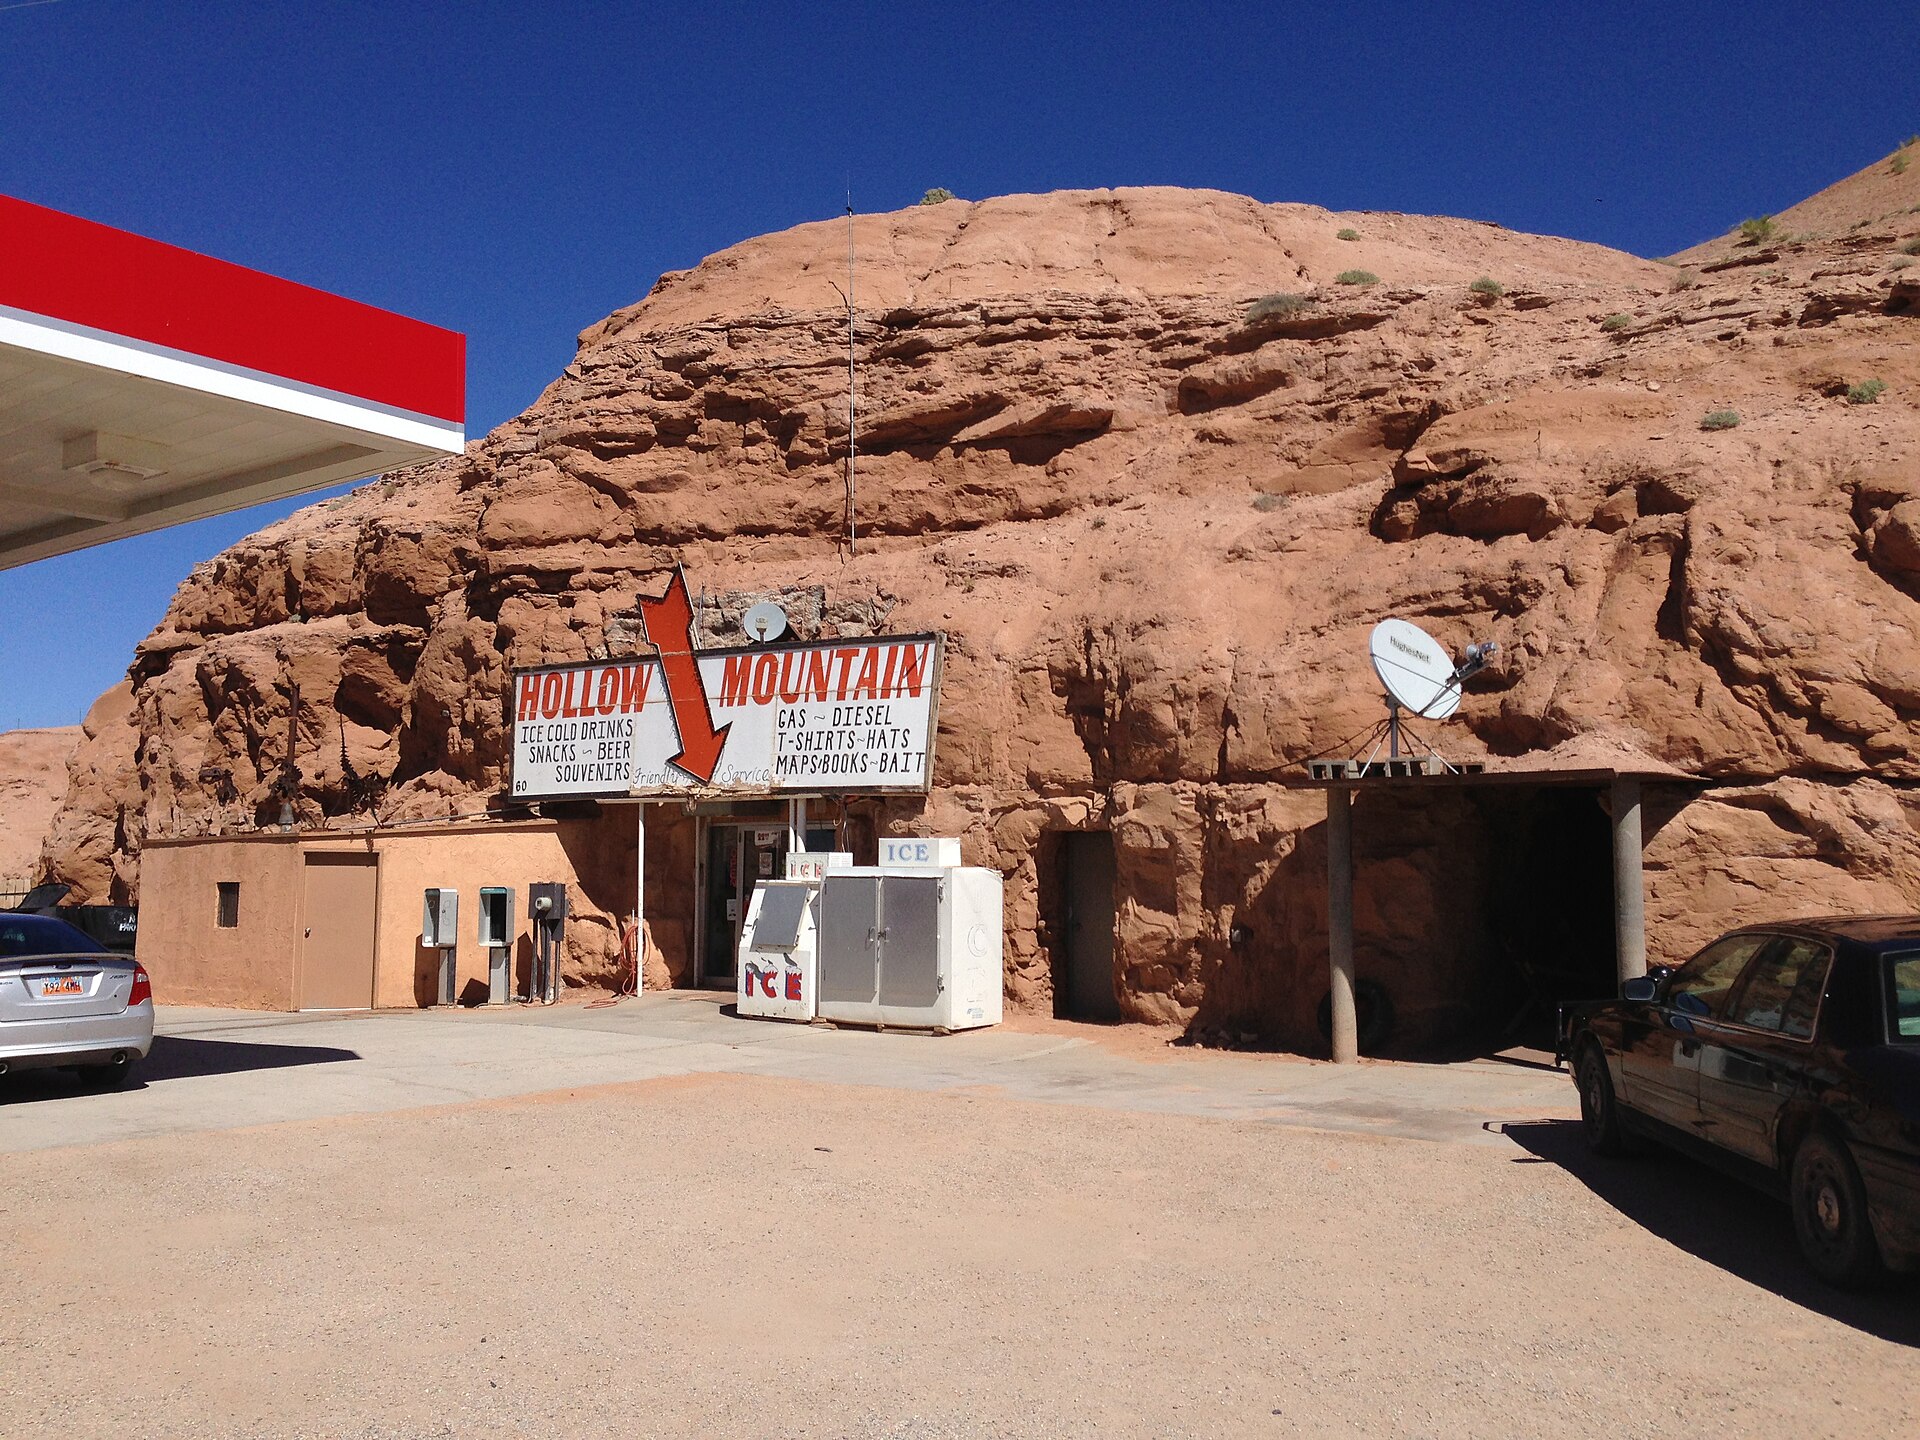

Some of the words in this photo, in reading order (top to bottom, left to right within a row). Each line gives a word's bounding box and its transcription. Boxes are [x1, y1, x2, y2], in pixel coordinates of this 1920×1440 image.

[1390, 635, 1430, 663] HughesNet
[518, 664, 654, 721] HOLLOW
[719, 643, 929, 707] MOUNTAIN
[778, 708, 806, 729] GAS
[832, 705, 892, 727] DIESEL
[520, 725, 543, 744] ICE
[547, 722, 577, 742] COLD
[581, 719, 633, 740] DRINKS
[529, 744, 576, 763] SNACKS
[597, 741, 630, 760] BEER
[555, 762, 630, 782] SOUVENIRS
[721, 764, 769, 784] Service
[515, 780, 527, 792] 60
[888, 844, 930, 862] ICE
[745, 963, 802, 1000] ICE
